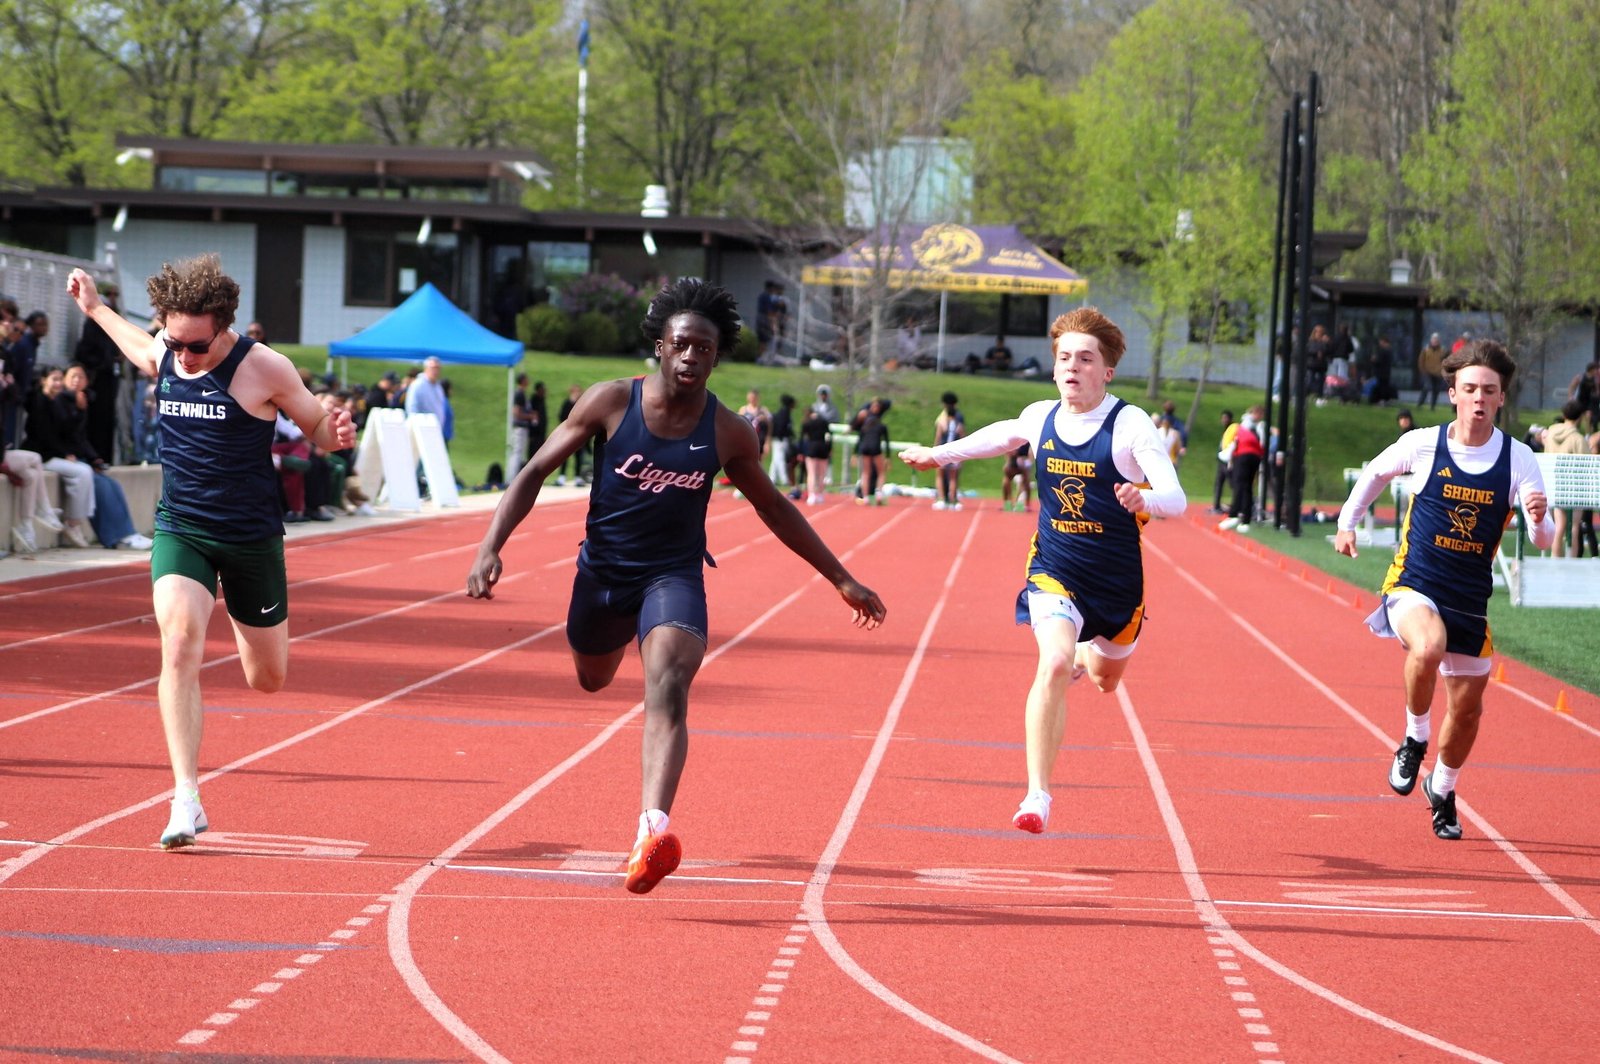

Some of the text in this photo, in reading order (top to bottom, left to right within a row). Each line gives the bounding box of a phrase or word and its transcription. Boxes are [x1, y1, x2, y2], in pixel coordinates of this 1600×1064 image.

[159, 399, 226, 419] REENHILLS
[615, 454, 706, 493] Liggett
[1046, 457, 1096, 478] SHRINE
[1442, 483, 1495, 505] SHRINE
[1050, 518, 1103, 533] KNIGHTS
[1434, 534, 1484, 554] KNIGHTS
